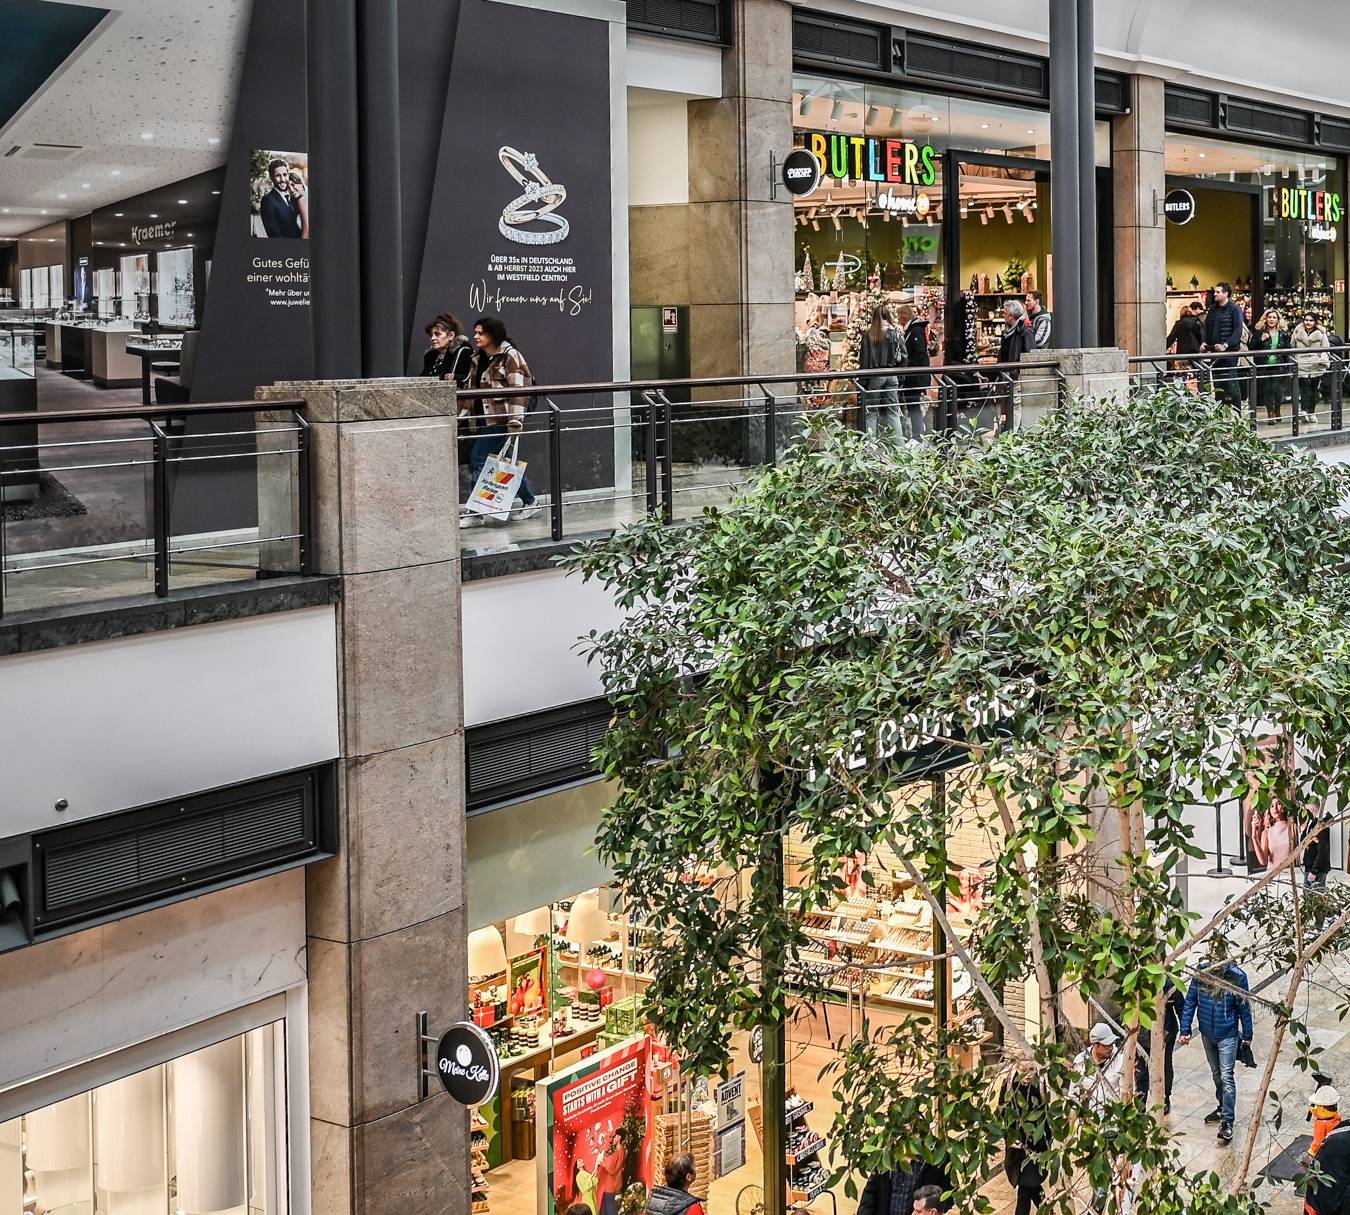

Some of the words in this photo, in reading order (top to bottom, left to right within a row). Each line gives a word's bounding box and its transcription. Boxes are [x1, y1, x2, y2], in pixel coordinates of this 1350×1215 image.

[811, 133, 936, 187] BUTLERS
[1165, 202, 1191, 212] BUTLERS
[1281, 187, 1342, 223] BUTLERS
[253, 257, 283, 268] Gutes
[285, 258, 310, 269] Gefü
[491, 255, 508, 264] ÜBER
[529, 257, 574, 265] DEUTSCHLAND
[487, 264, 493, 272] &
[504, 265, 528, 273] HERBST
[247, 272, 272, 282] einer
[506, 274, 540, 282] WESTFIELD
[541, 274, 568, 282] CENTRO!
[287, 289, 302, 297] über
[470, 279, 494, 313] Wir
[495, 288, 529, 312] freuen
[549, 288, 567, 312] auf
[568, 285, 592, 316] Sie!
[439, 1057, 466, 1076] Meine
[564, 1078, 602, 1101] POSITIVE
[602, 1060, 637, 1081] CHANGE
[562, 1095, 586, 1116] STARTS
[606, 1070, 638, 1093] GIFT
[721, 1082, 742, 1102] ADVENT
